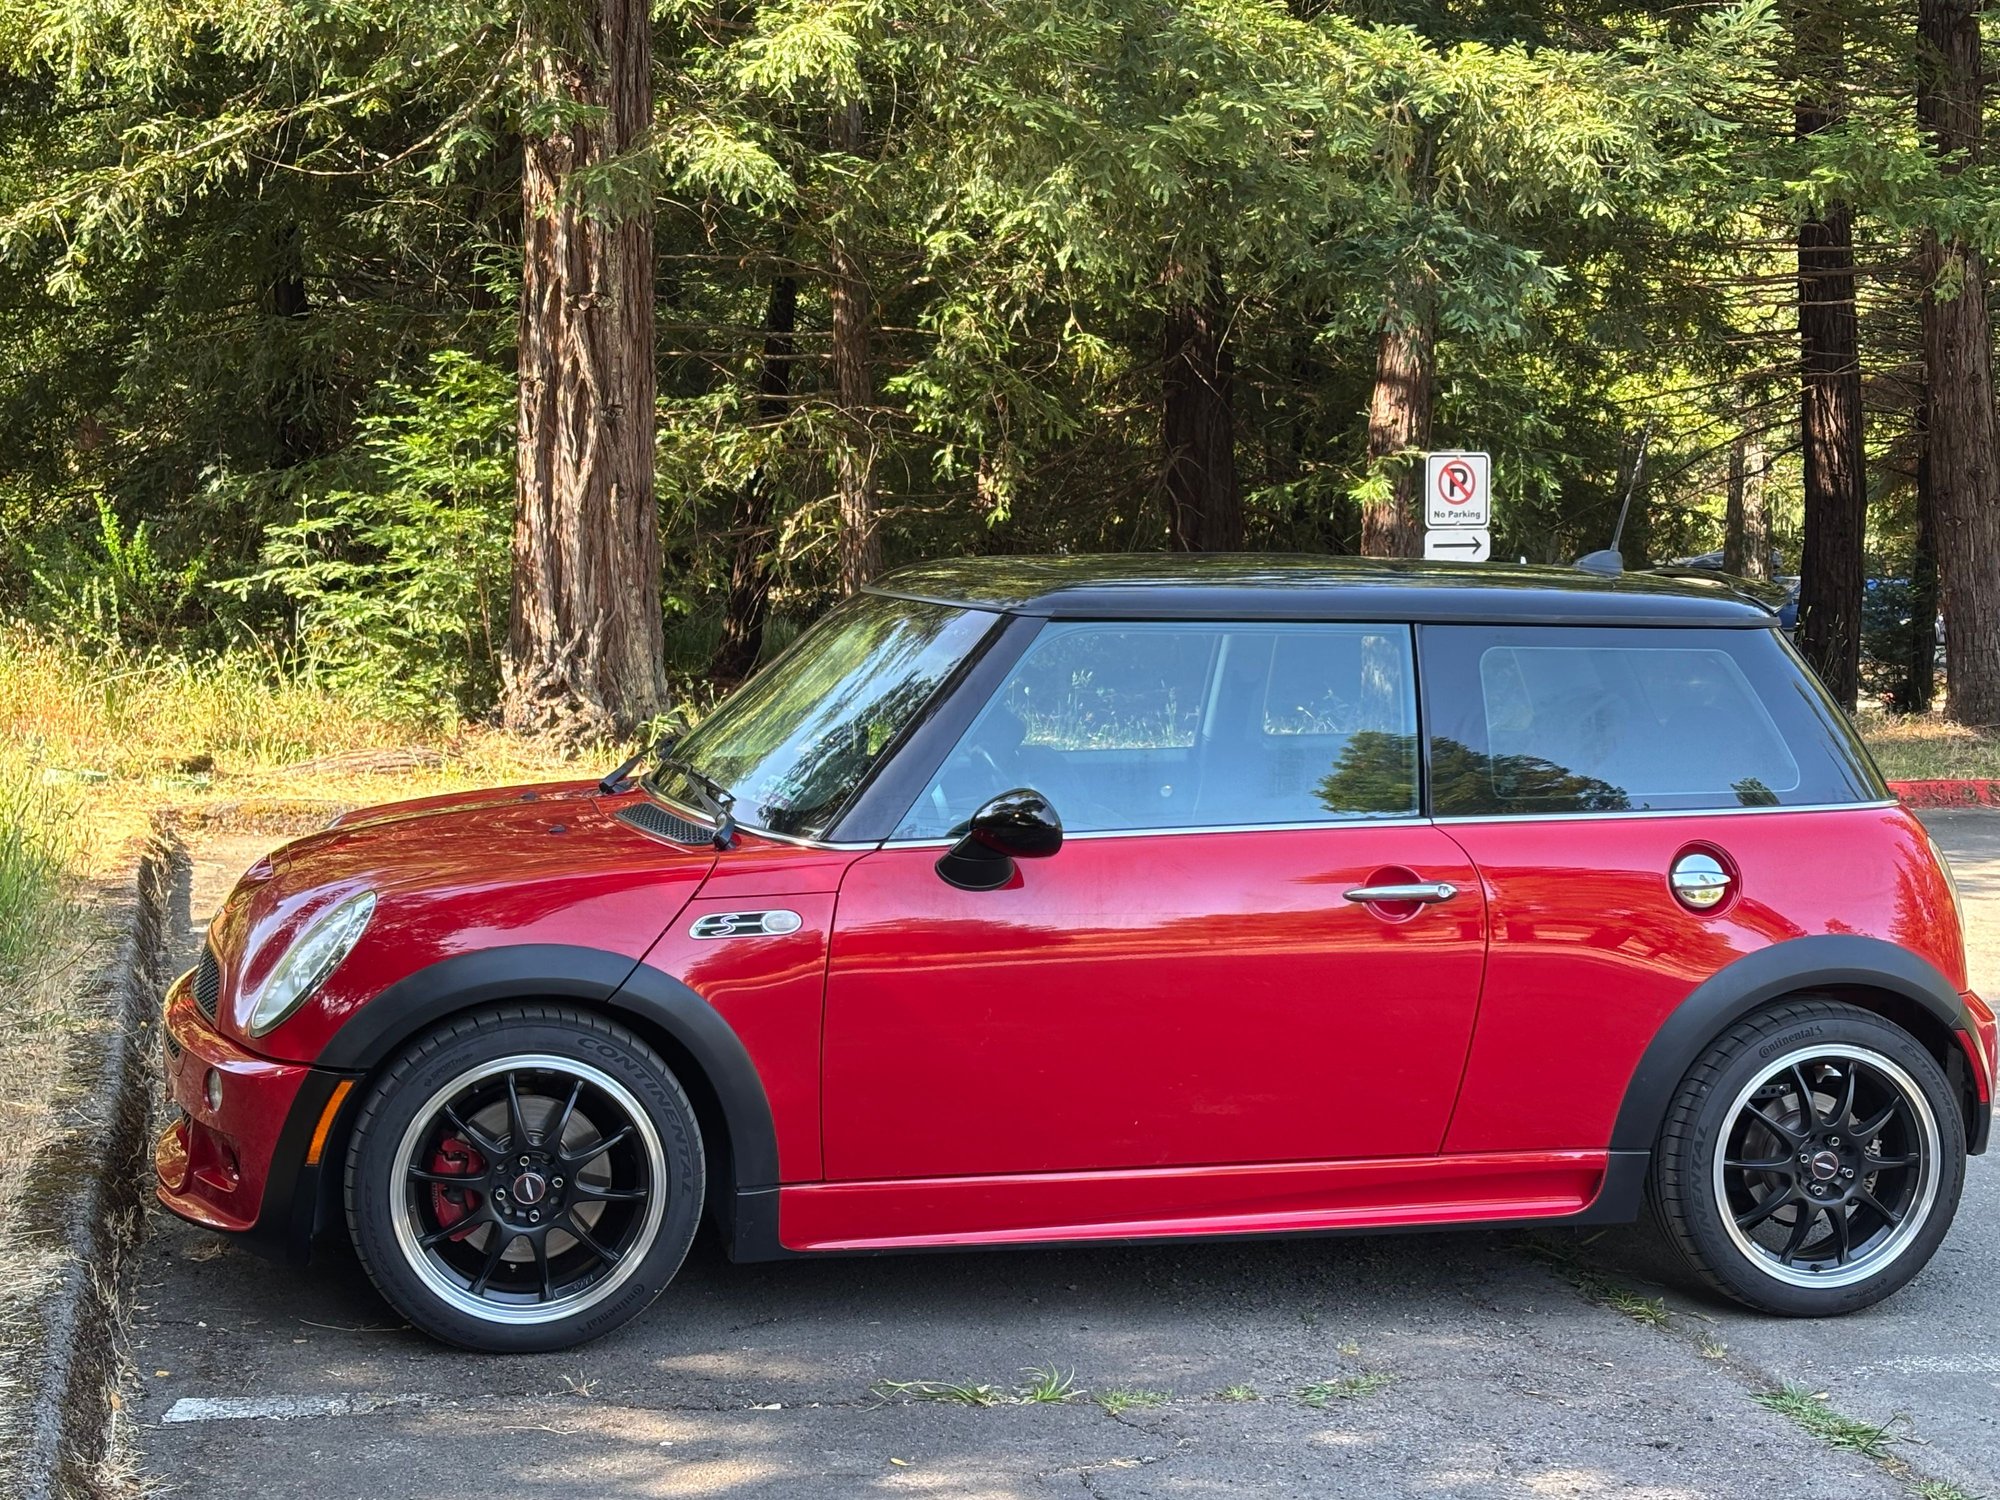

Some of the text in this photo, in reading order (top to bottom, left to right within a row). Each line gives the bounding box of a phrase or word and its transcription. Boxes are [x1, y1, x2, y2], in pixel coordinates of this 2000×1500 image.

[1448, 467, 1468, 498] P
[1433, 510, 1481, 519] No Parking
[1758, 1027, 1815, 1059] Continental
[577, 1037, 693, 1193] CONTINENTAL
[586, 1282, 647, 1331] Continental
